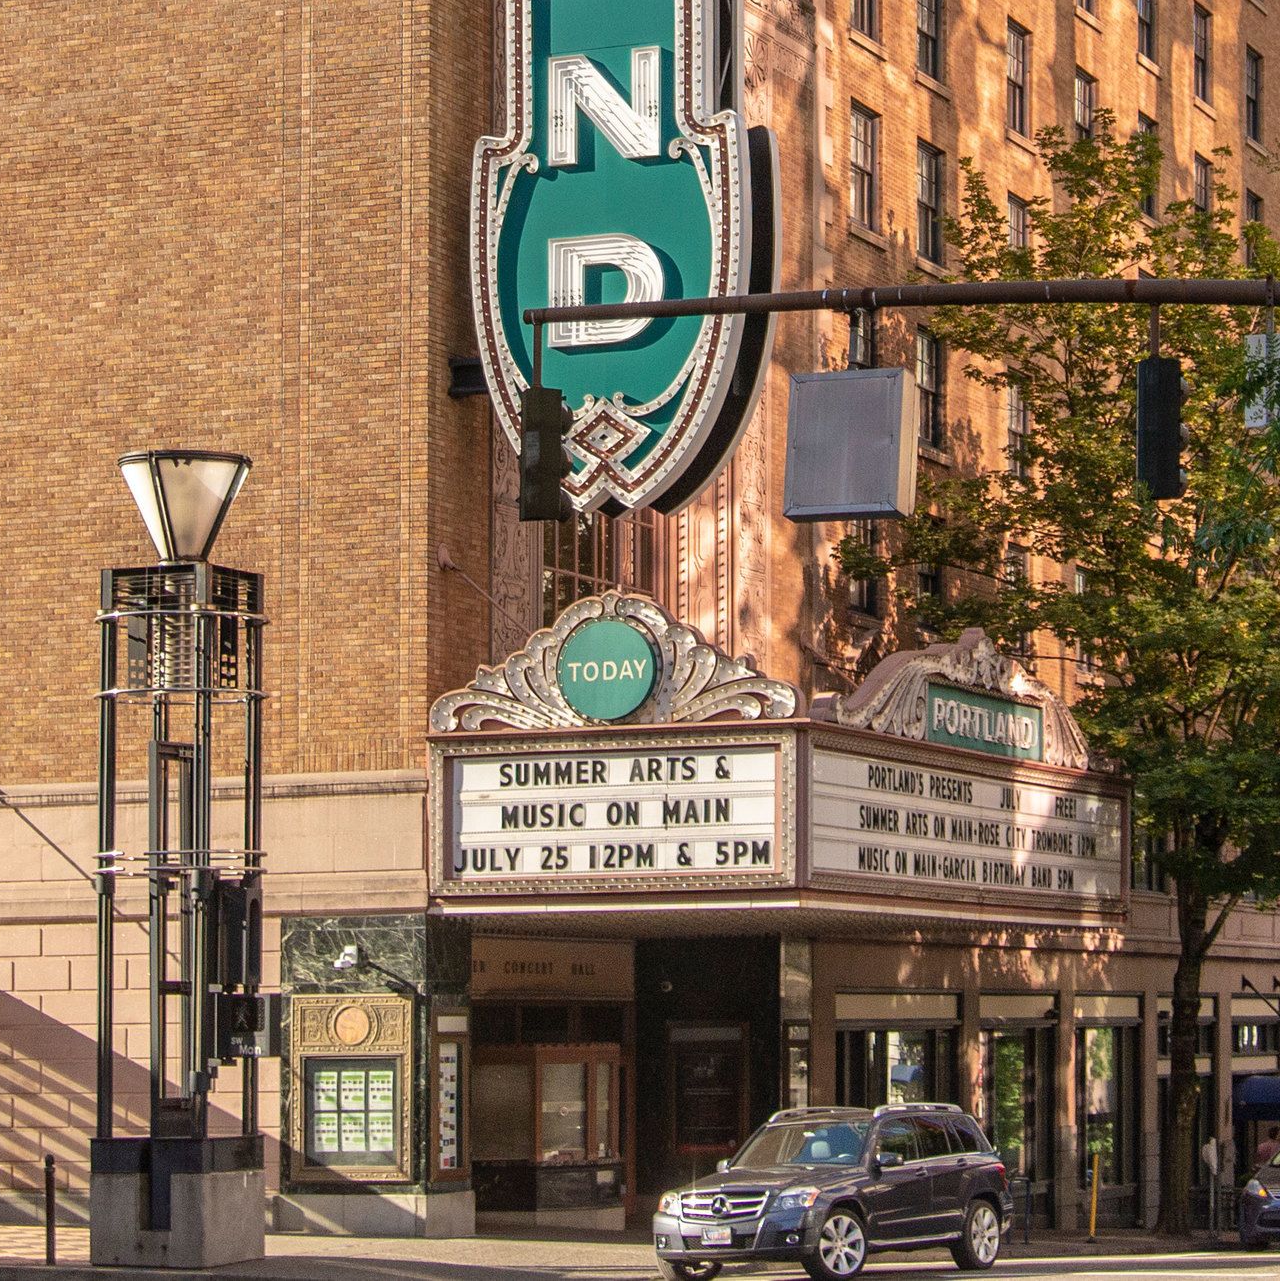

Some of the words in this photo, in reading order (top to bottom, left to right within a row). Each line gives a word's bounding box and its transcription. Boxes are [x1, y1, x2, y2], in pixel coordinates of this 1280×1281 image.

[567, 659, 647, 682] TODAY
[932, 697, 1038, 750] PORTLAND
[499, 760, 608, 787] SUMMER
[630, 757, 696, 783] ARTS
[715, 755, 731, 780] &
[929, 775, 973, 803] PRESENTS
[1000, 787, 1021, 810] JULY
[1055, 797, 1077, 818] FREE!
[501, 803, 585, 829] MUSIC
[607, 802, 639, 827] ON
[663, 798, 730, 825] MAIN
[859, 805, 899, 833] SUMMER
[905, 812, 928, 836] ARTS
[934, 816, 946, 838] ON
[1006, 825, 1026, 849] CITY
[1031, 830, 1072, 854] TROMBONE
[1077, 834, 1096, 856] 12PM
[454, 847, 520, 873] JULY
[541, 846, 569, 870] 25
[589, 843, 655, 869] 12PM
[676, 842, 693, 867] &
[716, 840, 770, 866] 5PM
[858, 847, 890, 872] MUSIC
[895, 851, 908, 874] ON
[982, 861, 1026, 886] BIRTHDAY
[1031, 867, 1052, 888] BAND
[1058, 869, 1074, 890] 5PM
[504, 961, 554, 975] CONCERT
[231, 1037, 243, 1045] SW
